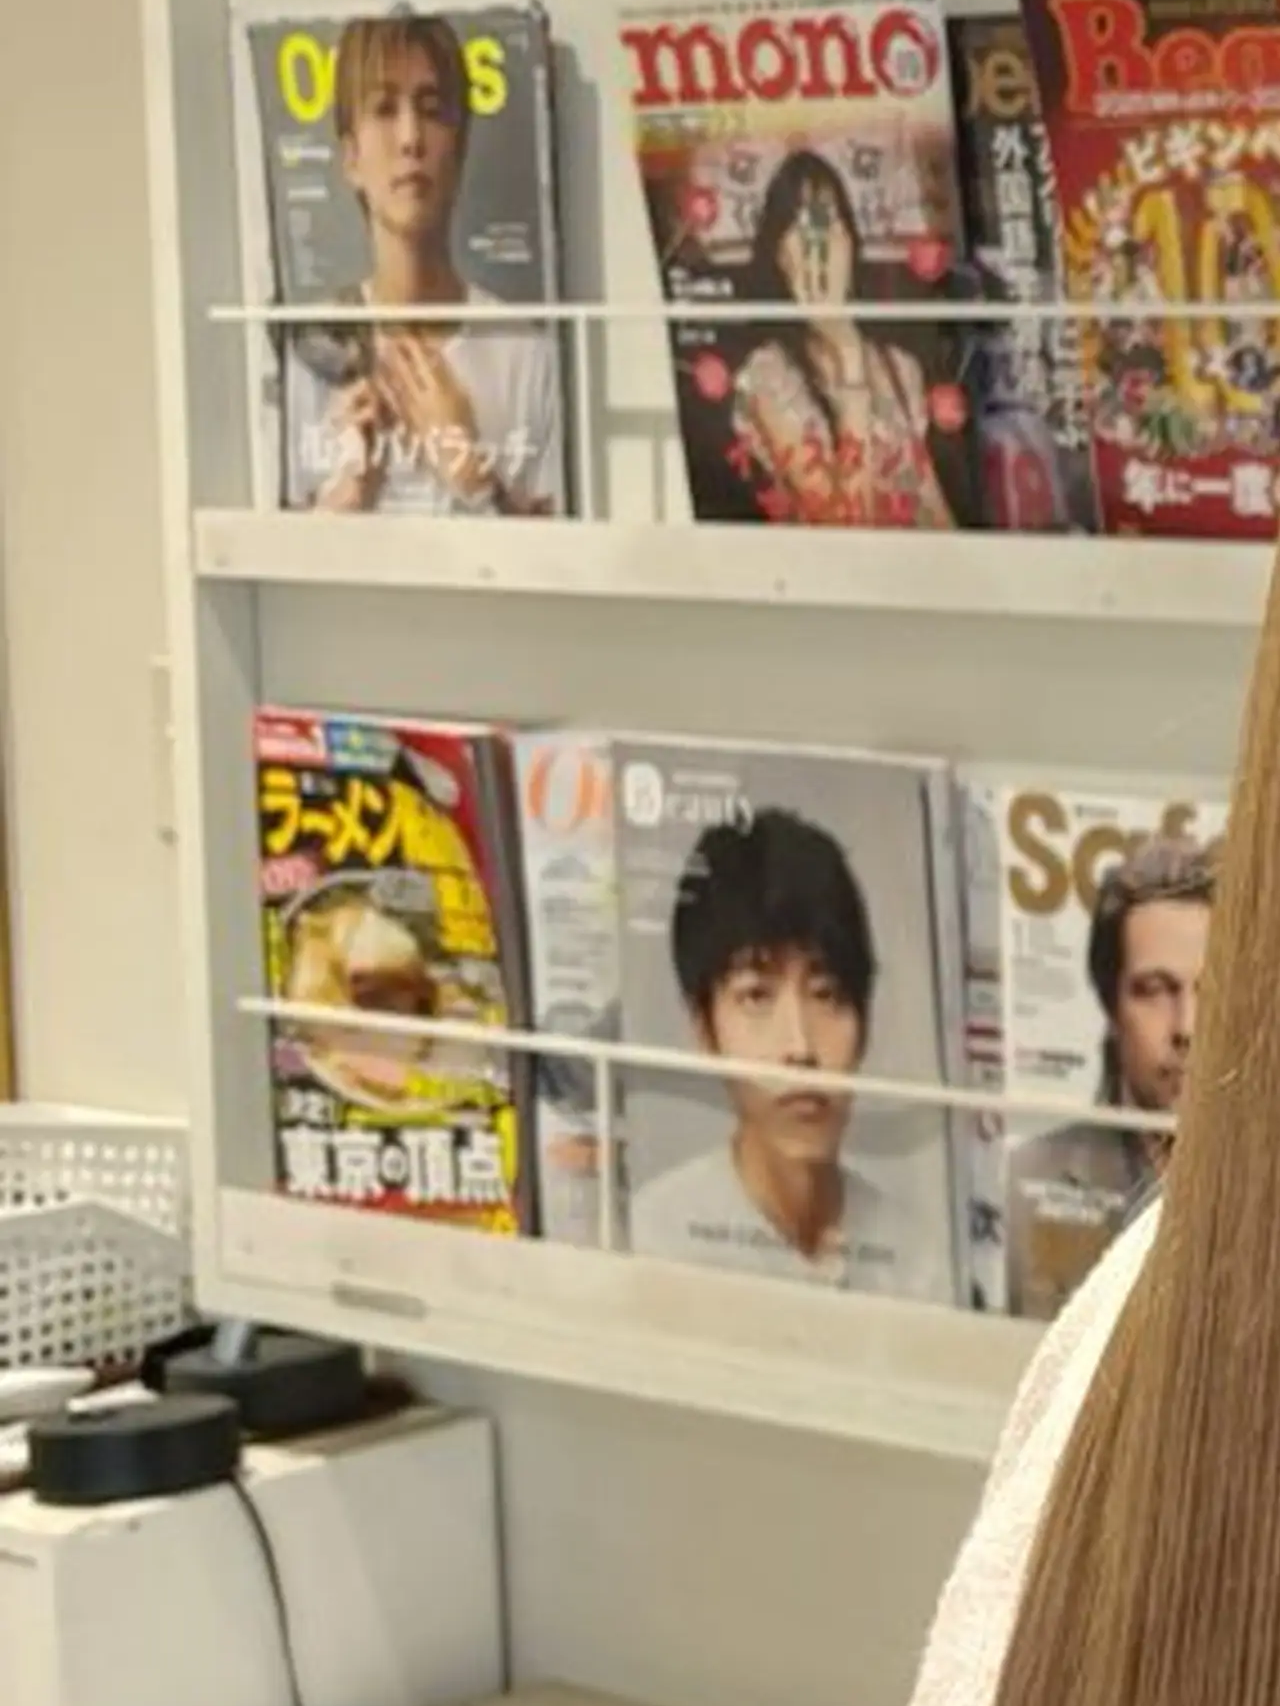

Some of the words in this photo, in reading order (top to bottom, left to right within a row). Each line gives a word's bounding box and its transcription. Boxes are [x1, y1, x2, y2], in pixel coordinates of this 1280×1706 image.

[620, 8, 940, 106] mono
[281, 1123, 508, 1205] 東京の頂点
